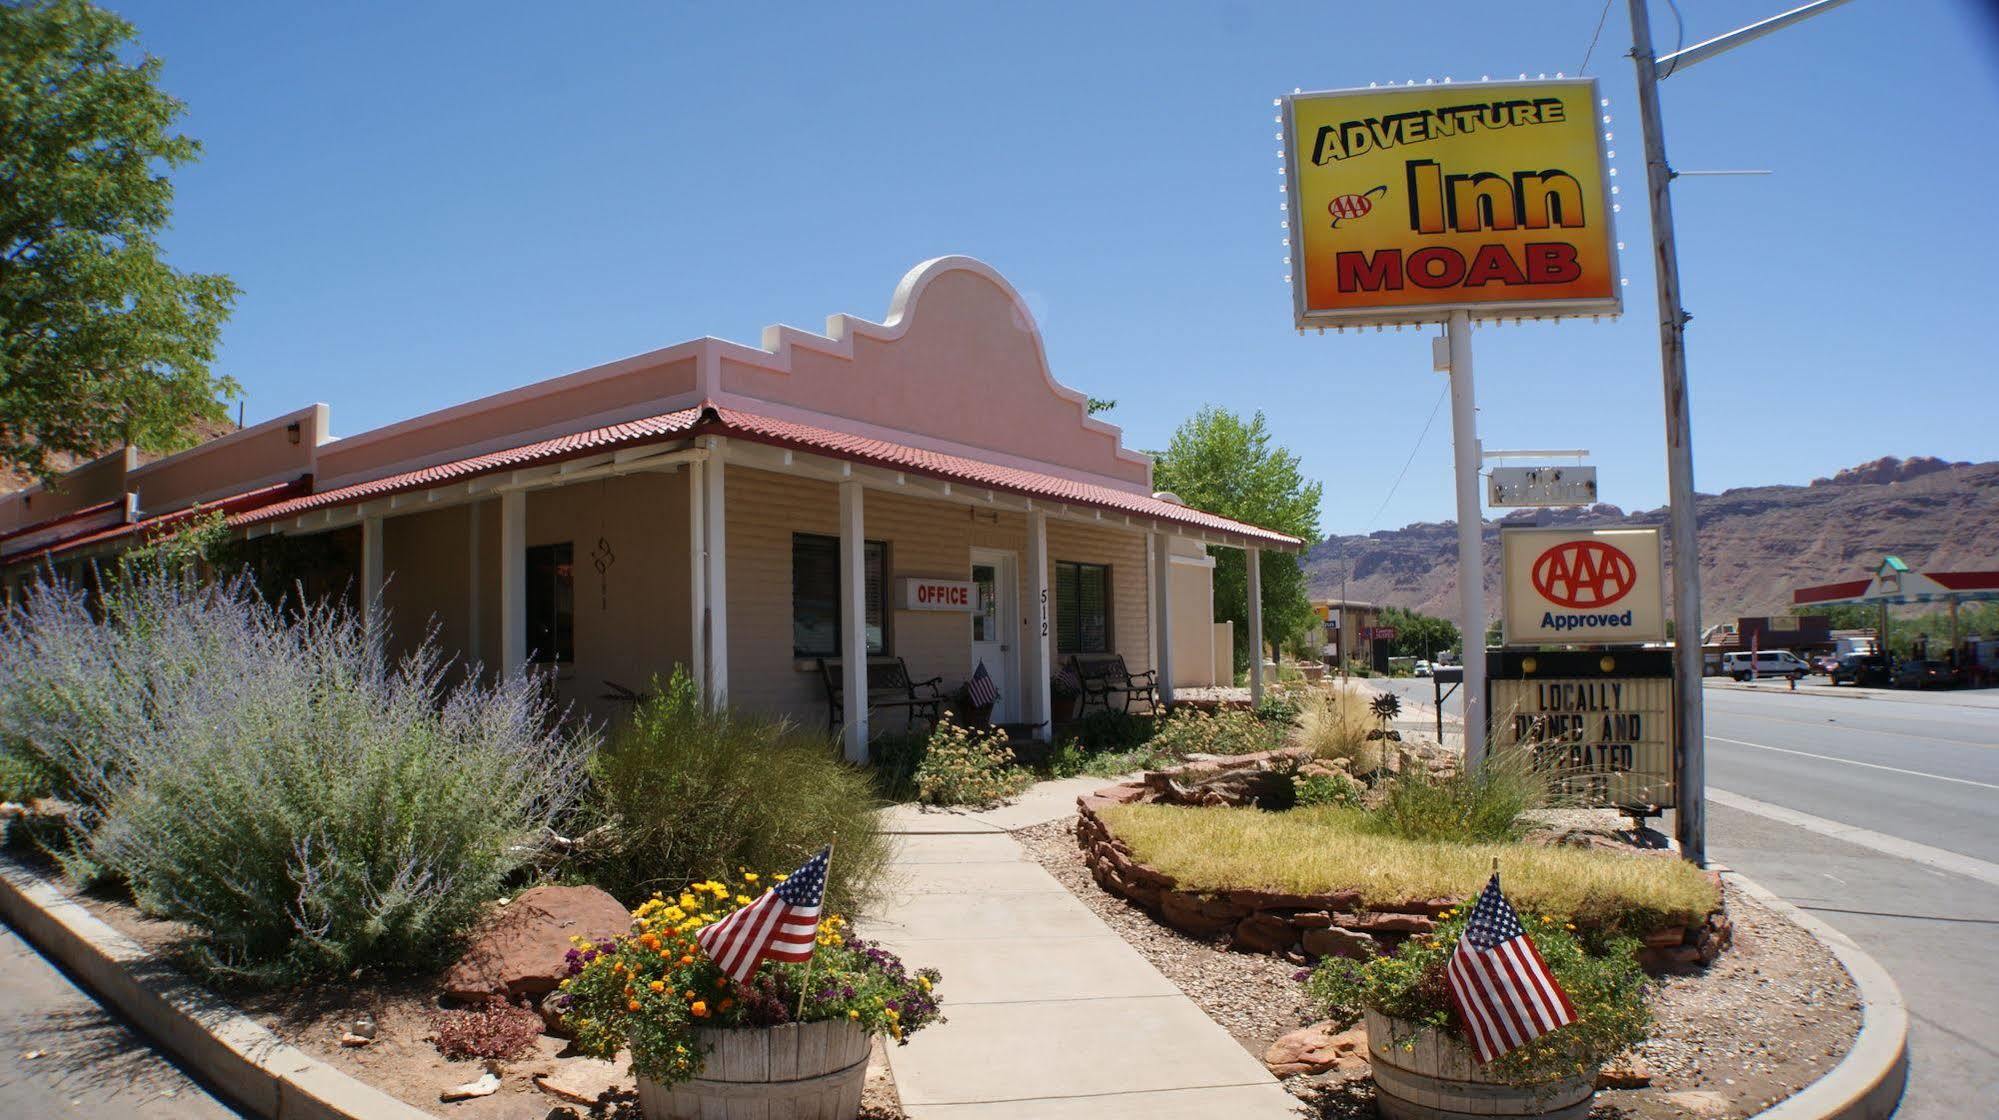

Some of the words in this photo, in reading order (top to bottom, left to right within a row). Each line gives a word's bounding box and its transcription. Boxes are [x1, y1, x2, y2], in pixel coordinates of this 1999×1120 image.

[1311, 98, 1566, 167] ADVENTURE
[1329, 195, 1371, 219] AAA
[1406, 159, 1586, 235] Inn
[1336, 242, 1582, 293] MOAB
[1538, 541, 1631, 609] AAA
[918, 584, 968, 605] OFFICE
[1041, 589, 1049, 637] 512
[1540, 610, 1632, 631] Approved
[1538, 683, 1622, 711] LOCALLY
[1602, 714, 1641, 742] AND
[1533, 744, 1633, 773] RATED
